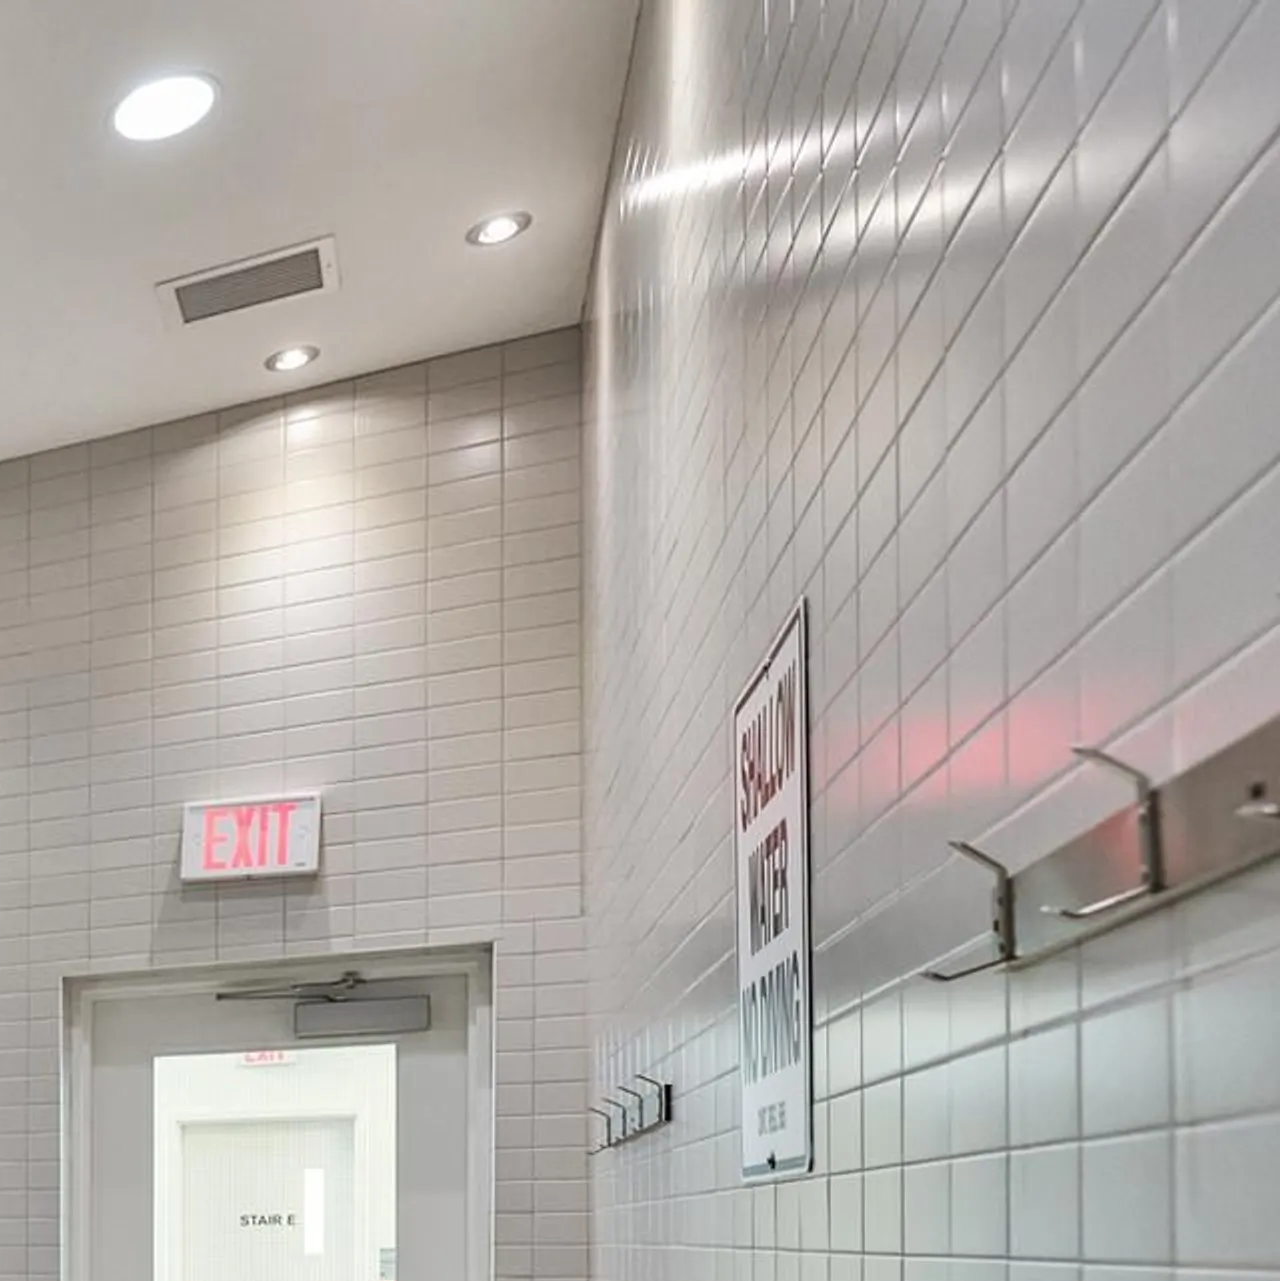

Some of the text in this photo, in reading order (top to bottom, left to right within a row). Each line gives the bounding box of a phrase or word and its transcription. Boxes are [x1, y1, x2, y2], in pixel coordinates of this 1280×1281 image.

[203, 802, 297, 869] EXIT
[240, 1214, 295, 1227] STAIR E
